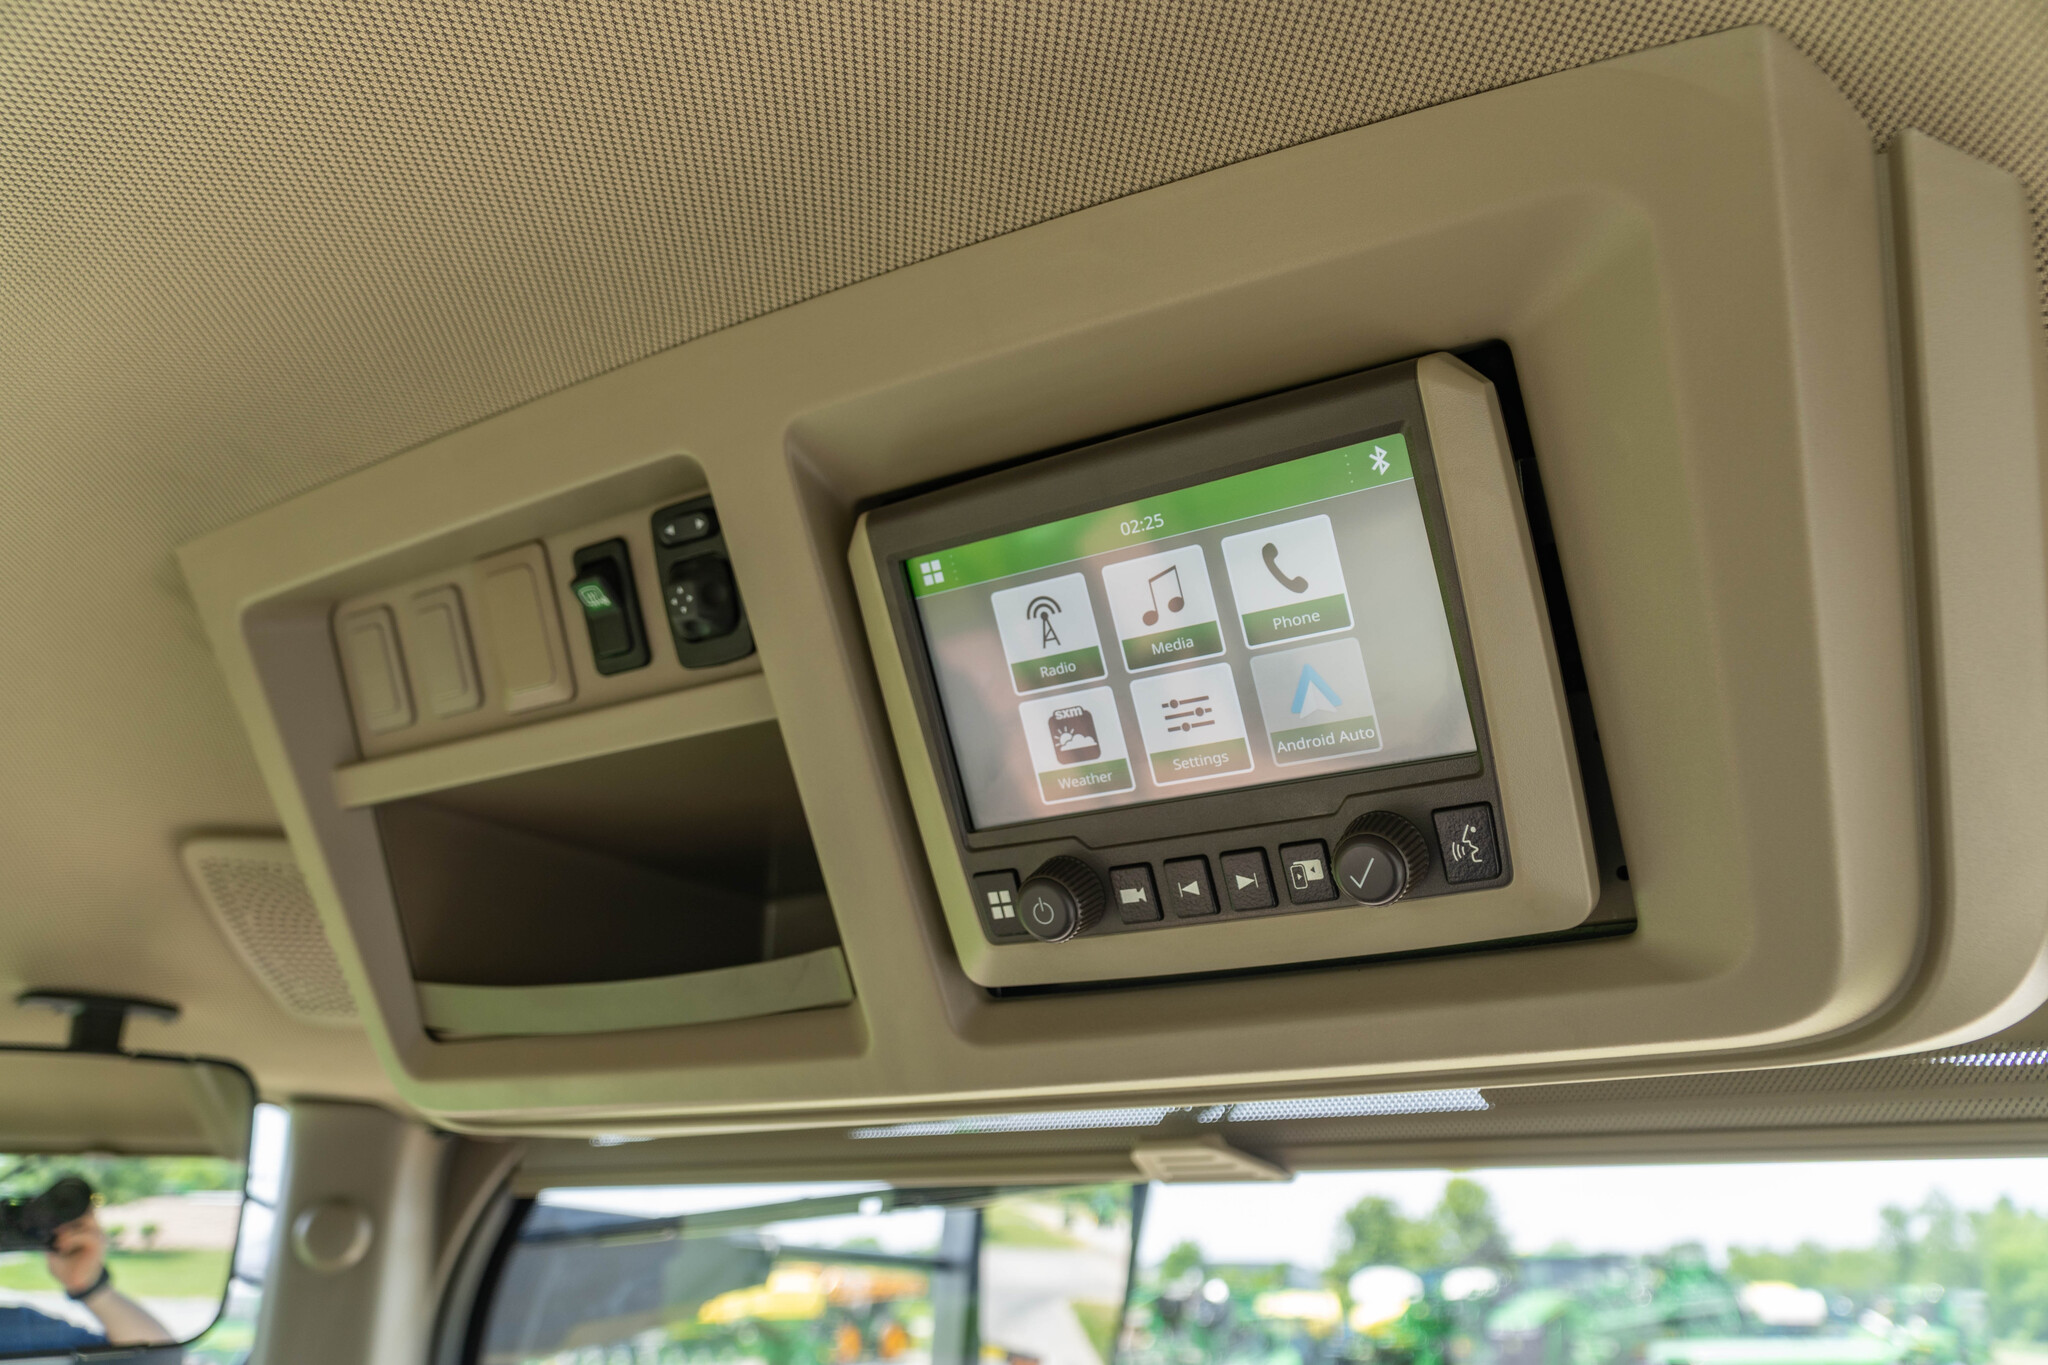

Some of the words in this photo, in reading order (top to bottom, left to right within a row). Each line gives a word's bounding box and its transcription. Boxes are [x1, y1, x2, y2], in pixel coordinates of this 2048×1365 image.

[1120, 513, 1165, 536] 02:25
[1272, 611, 1321, 630] Phone
[1151, 637, 1195, 655] Media
[1040, 660, 1077, 678] Radio
[1055, 706, 1083, 720] sxm
[1276, 733, 1336, 753] Android
[1339, 727, 1375, 743] Auto
[1172, 752, 1229, 771] Settings
[1058, 770, 1113, 788] Weather
